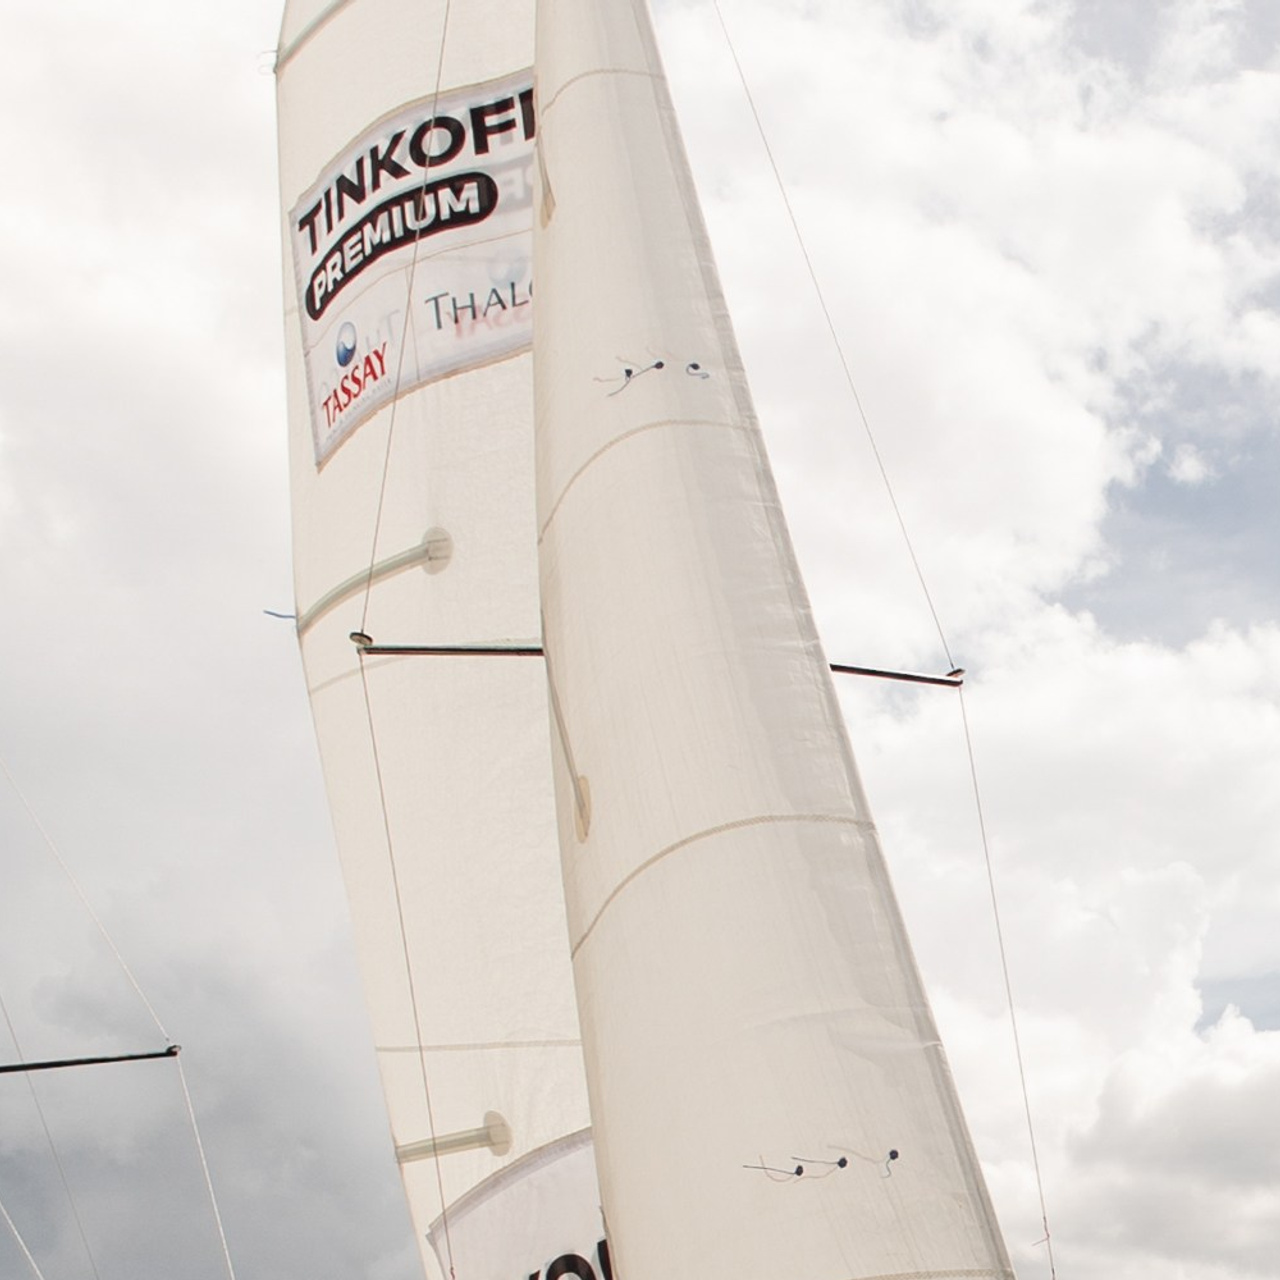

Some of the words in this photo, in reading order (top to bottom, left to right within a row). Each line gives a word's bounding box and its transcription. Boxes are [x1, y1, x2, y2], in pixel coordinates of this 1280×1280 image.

[313, 180, 480, 311] PREMIUM
[425, 281, 533, 330] THAL
[322, 341, 387, 428] TASSAY
